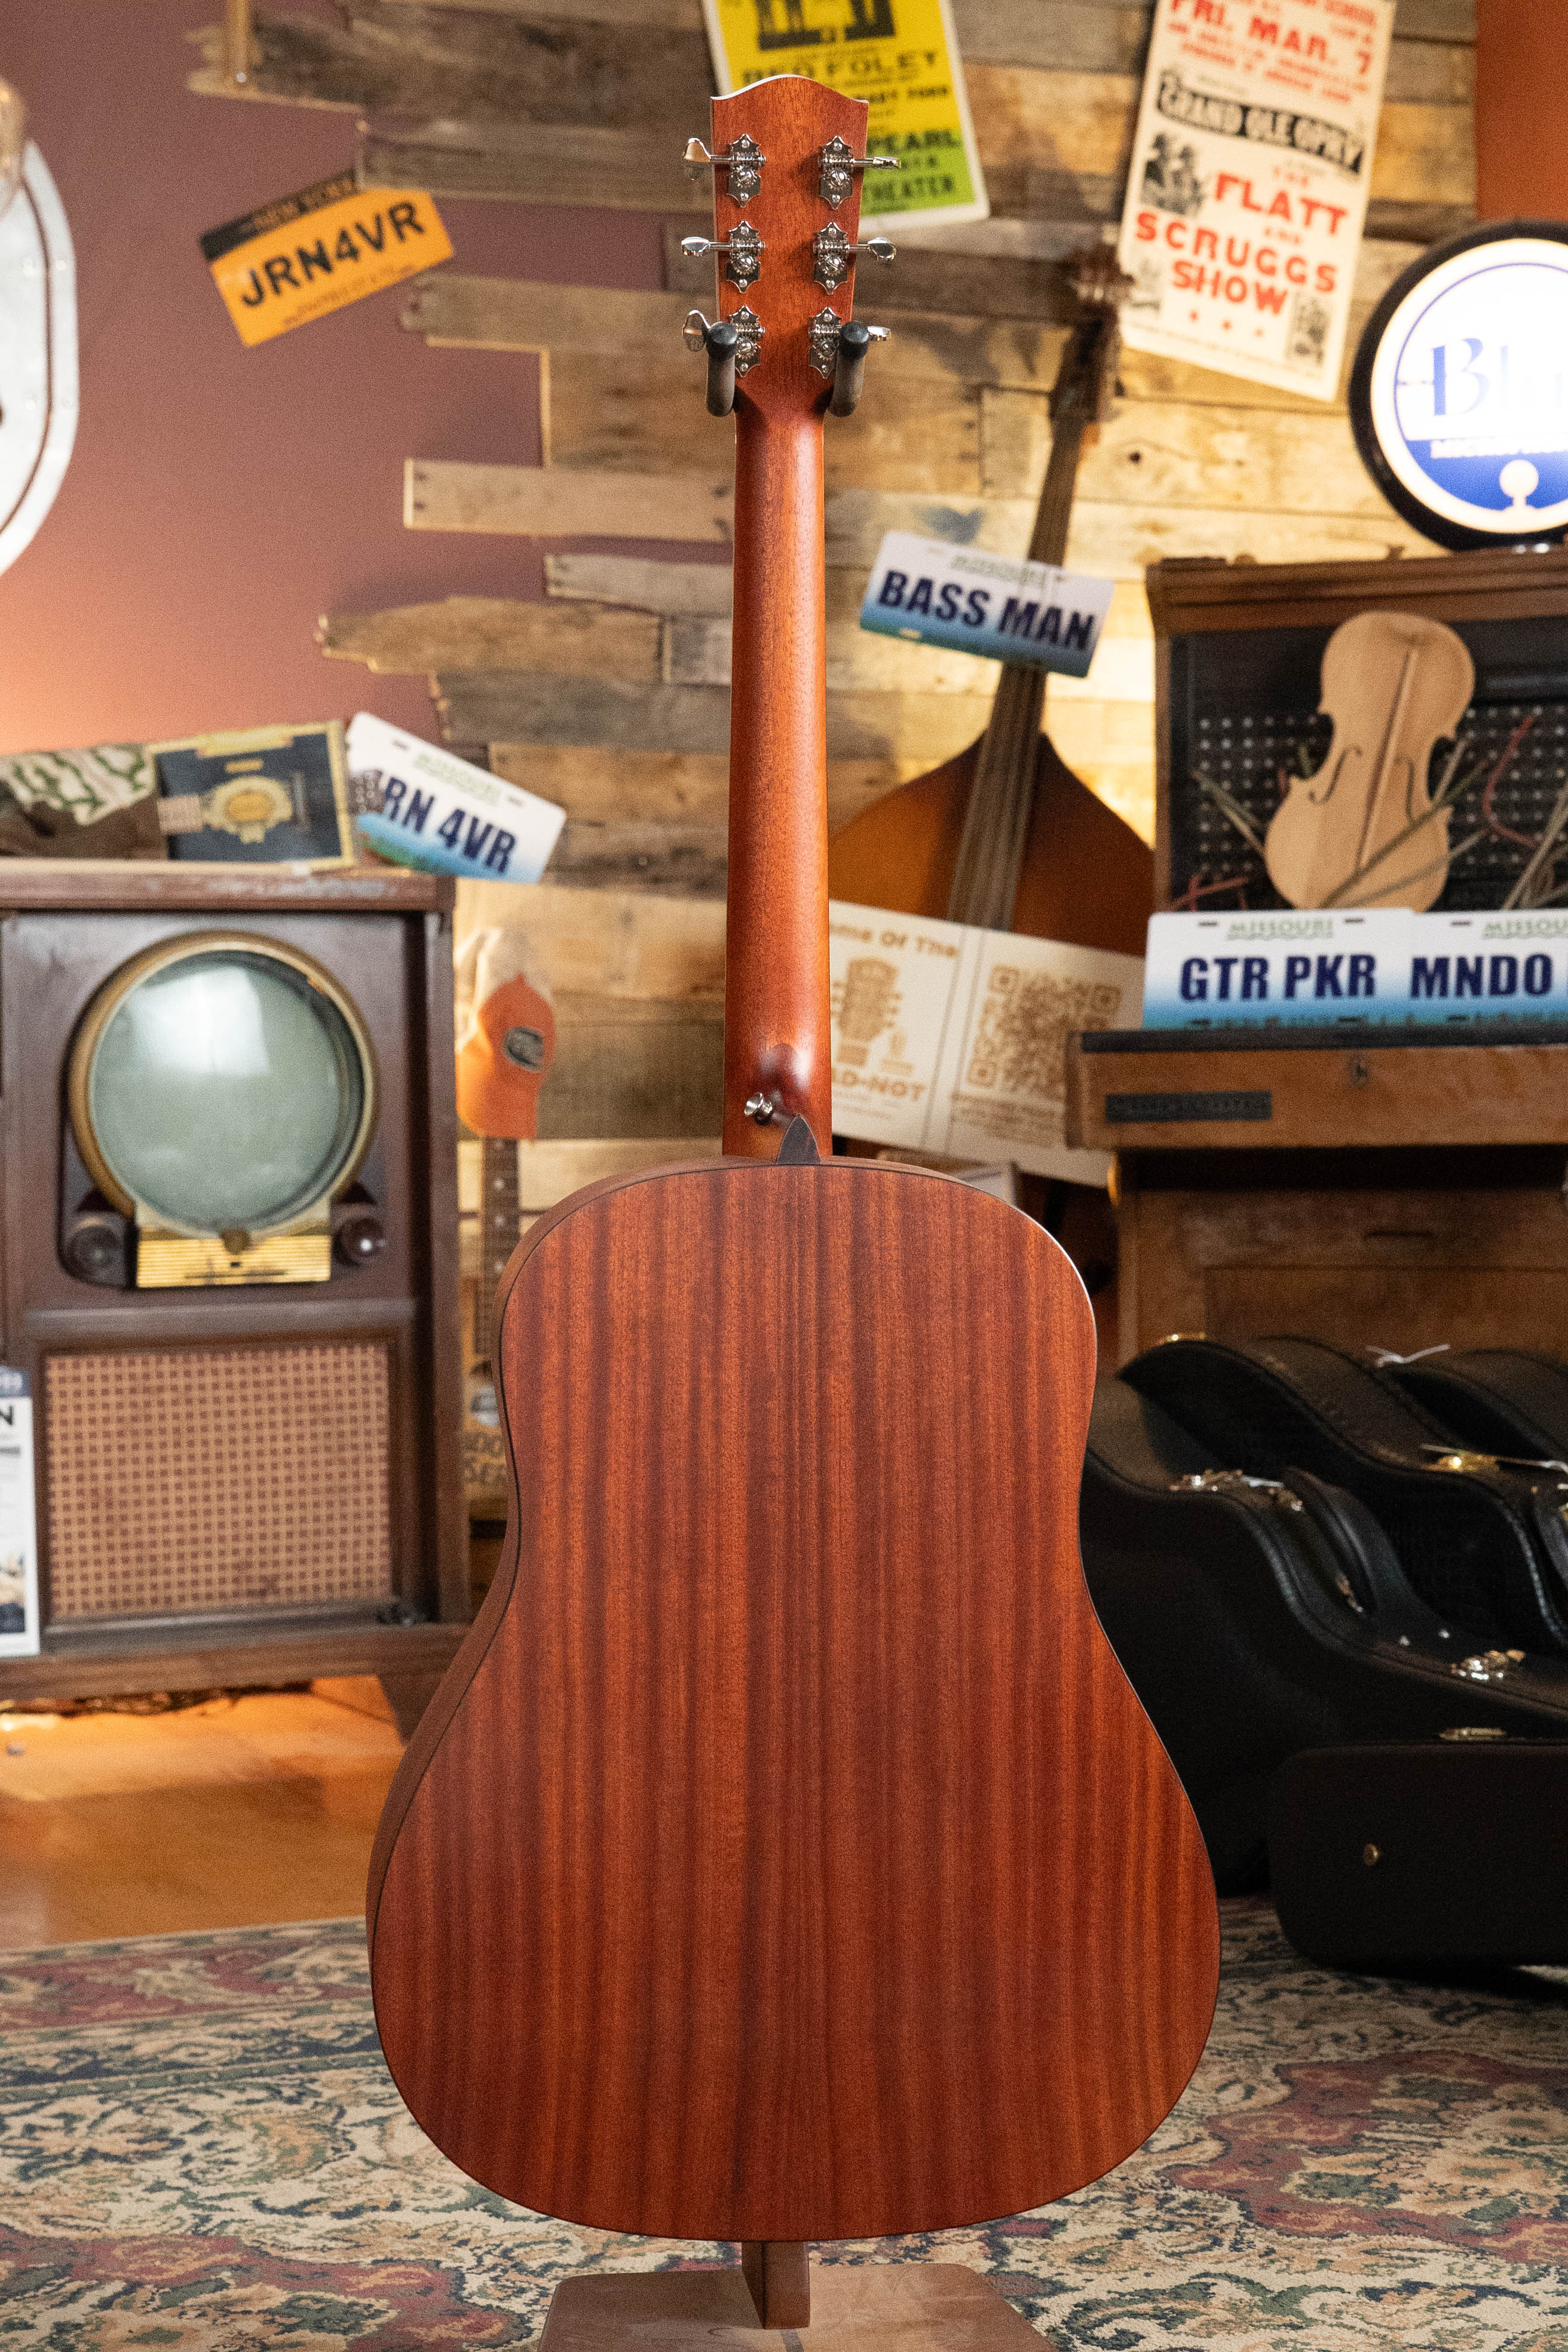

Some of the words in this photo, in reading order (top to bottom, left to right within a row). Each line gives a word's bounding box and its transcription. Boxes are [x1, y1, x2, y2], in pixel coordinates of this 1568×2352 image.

[1214, 172, 1348, 236] FLATT
[242, 201, 425, 308] JRN4VR
[1135, 211, 1337, 293] SCRUGGS
[1172, 259, 1288, 316] SHOW
[877, 569, 992, 628] BASS
[997, 595, 1096, 652] MAN
[383, 775, 436, 835] RN
[437, 807, 517, 875] 4VR
[1180, 956, 1270, 1002] GTR
[1284, 954, 1376, 1000] PKR
[1410, 953, 1553, 999] MNDO
